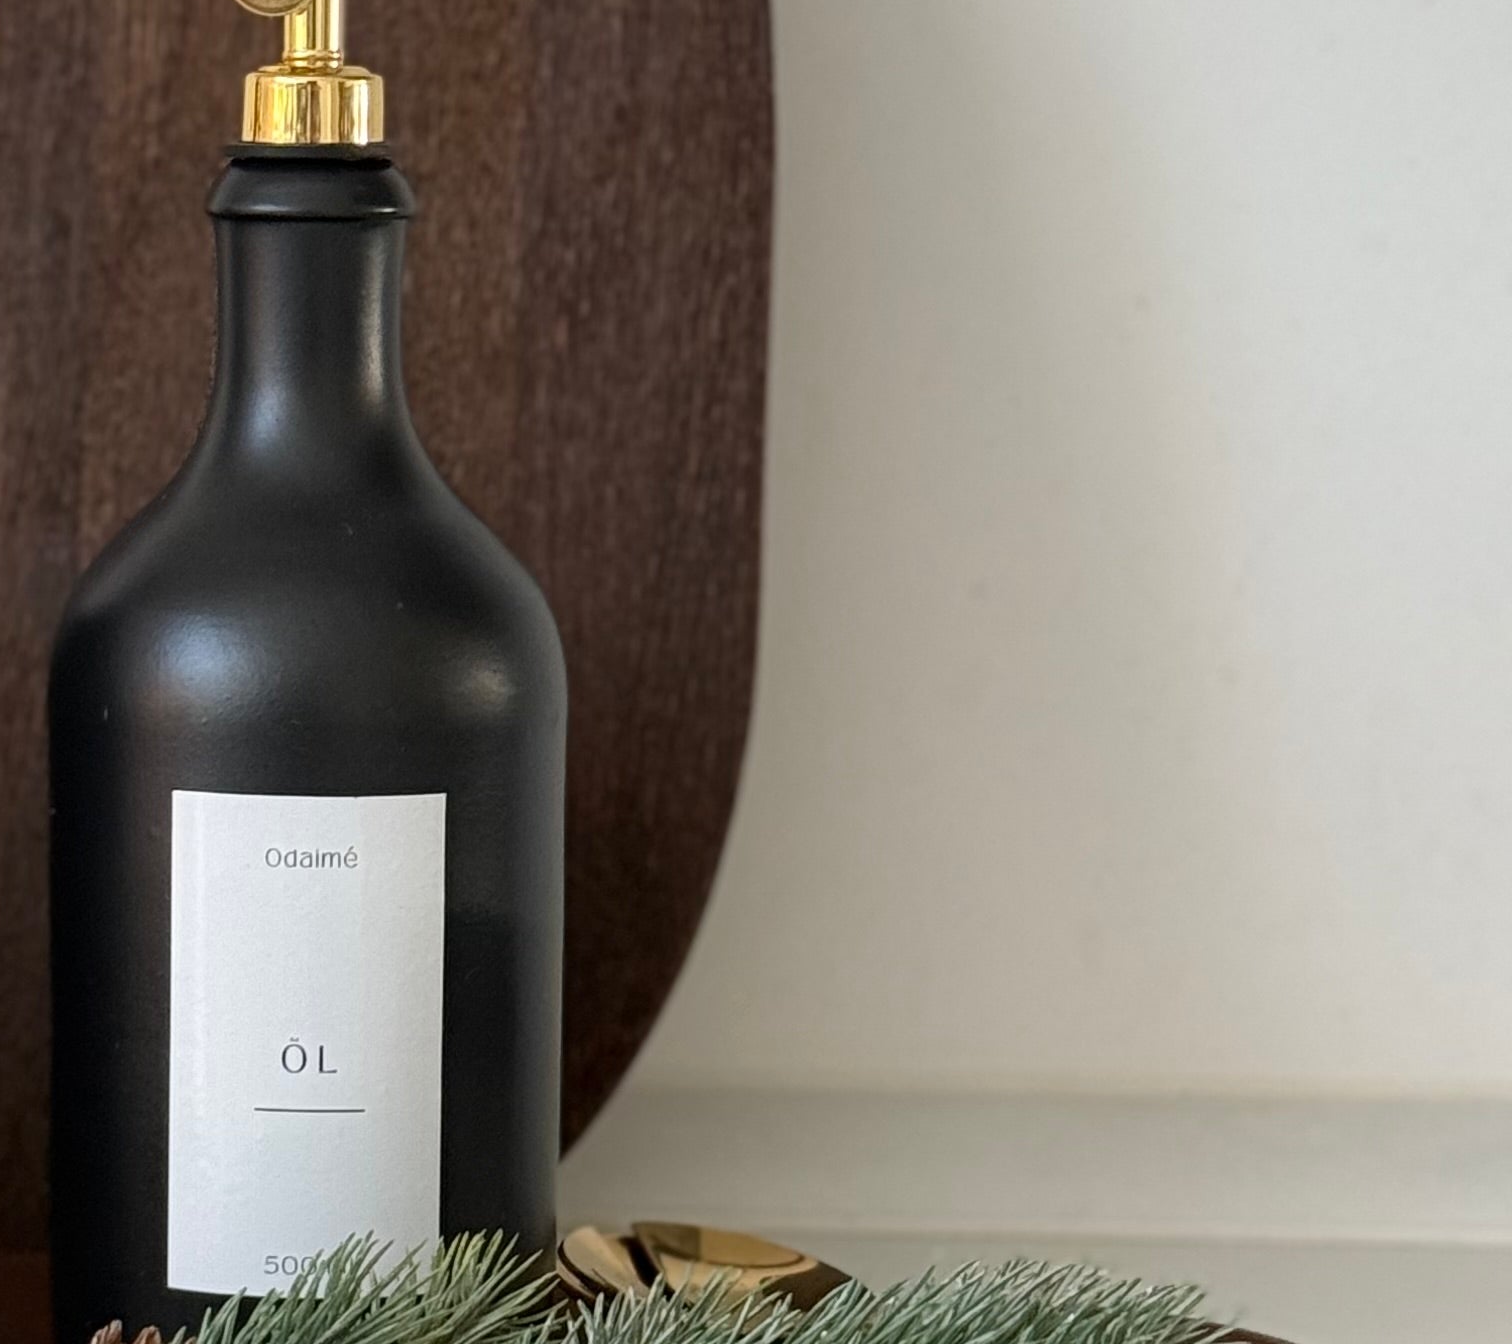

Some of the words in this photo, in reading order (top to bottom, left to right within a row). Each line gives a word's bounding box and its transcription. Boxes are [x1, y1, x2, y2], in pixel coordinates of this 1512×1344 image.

[264, 845, 359, 870] Odaimé
[280, 1036, 338, 1075] ÖL
[263, 1255, 317, 1276] 500
